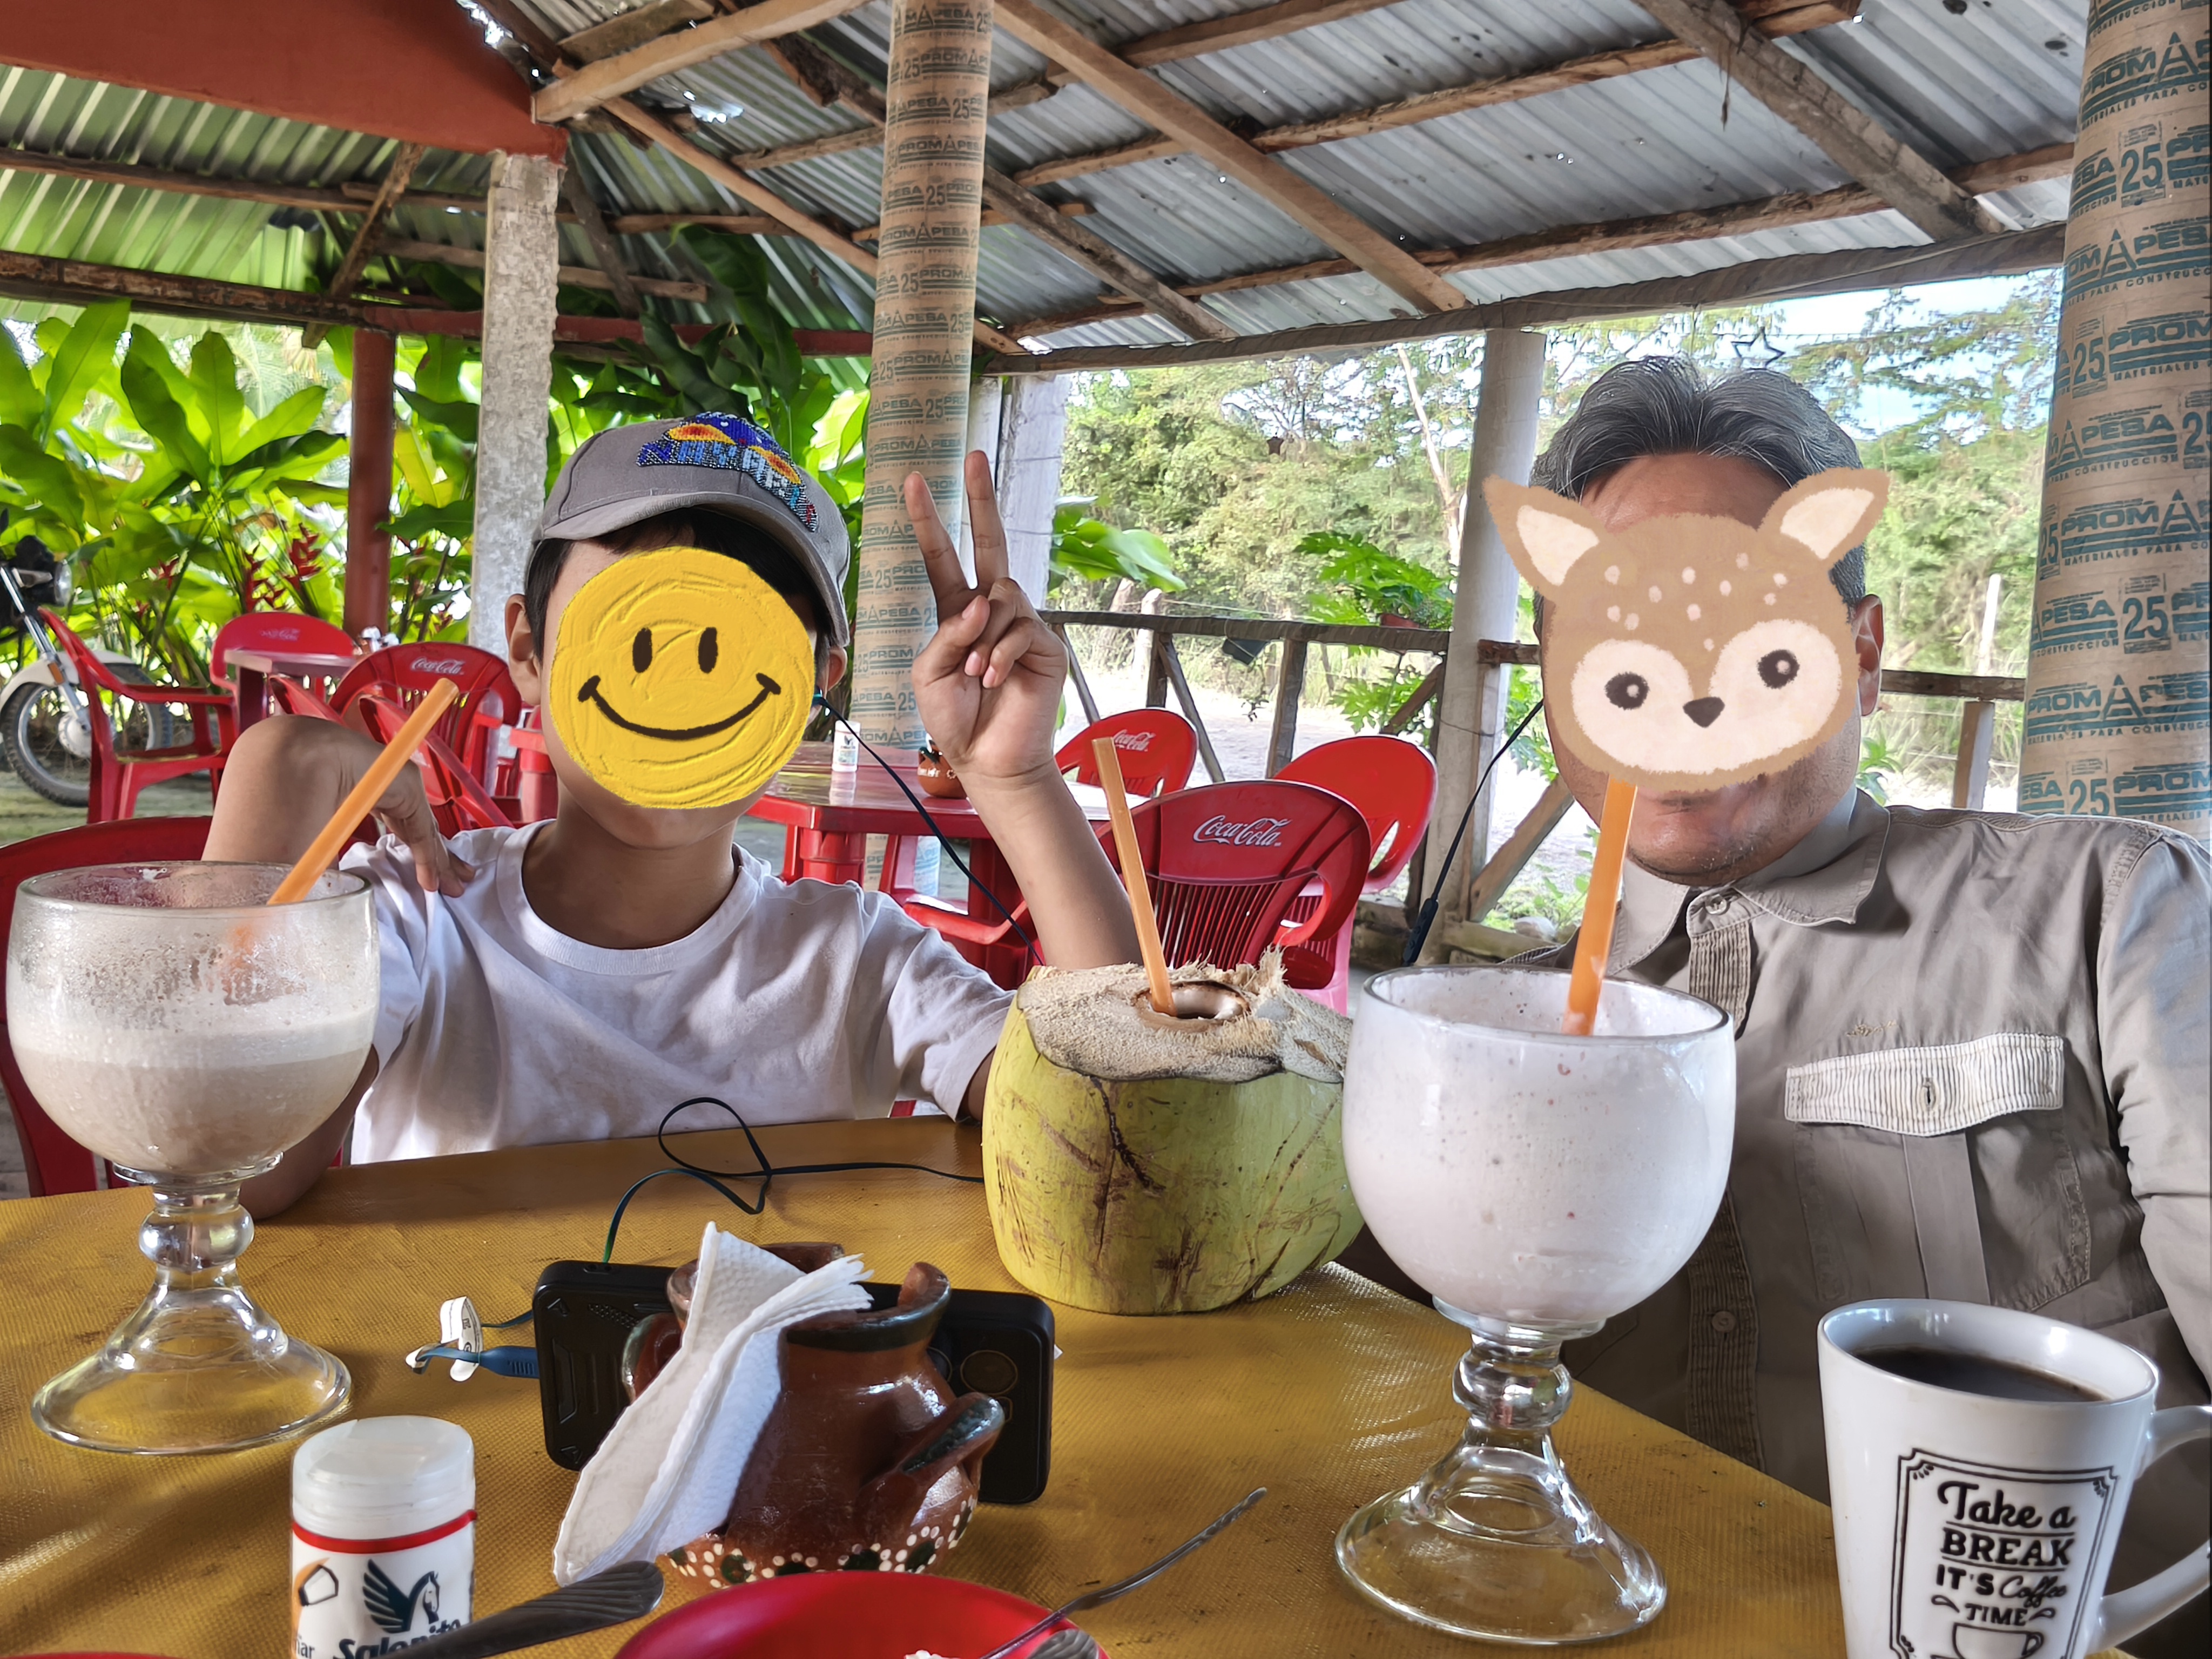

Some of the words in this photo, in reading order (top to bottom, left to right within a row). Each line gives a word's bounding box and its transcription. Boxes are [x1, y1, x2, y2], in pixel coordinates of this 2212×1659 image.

[2121, 143, 2163, 194] 25
[2073, 337, 2105, 385] 25
[2182, 411, 2210, 455] 2
[2040, 523, 2059, 567] 25
[875, 569, 892, 589] 25
[2123, 595, 2169, 640] 25
[2069, 778, 2110, 816] 25
[1937, 1480, 2042, 1529] Take
[2048, 1506, 2076, 1529] a
[1940, 1527, 2075, 1566] BREAK
[1935, 1563, 1994, 1596] IT'S
[1999, 1574, 2067, 1608] Coffee
[1965, 1602, 2027, 1626] TIME
